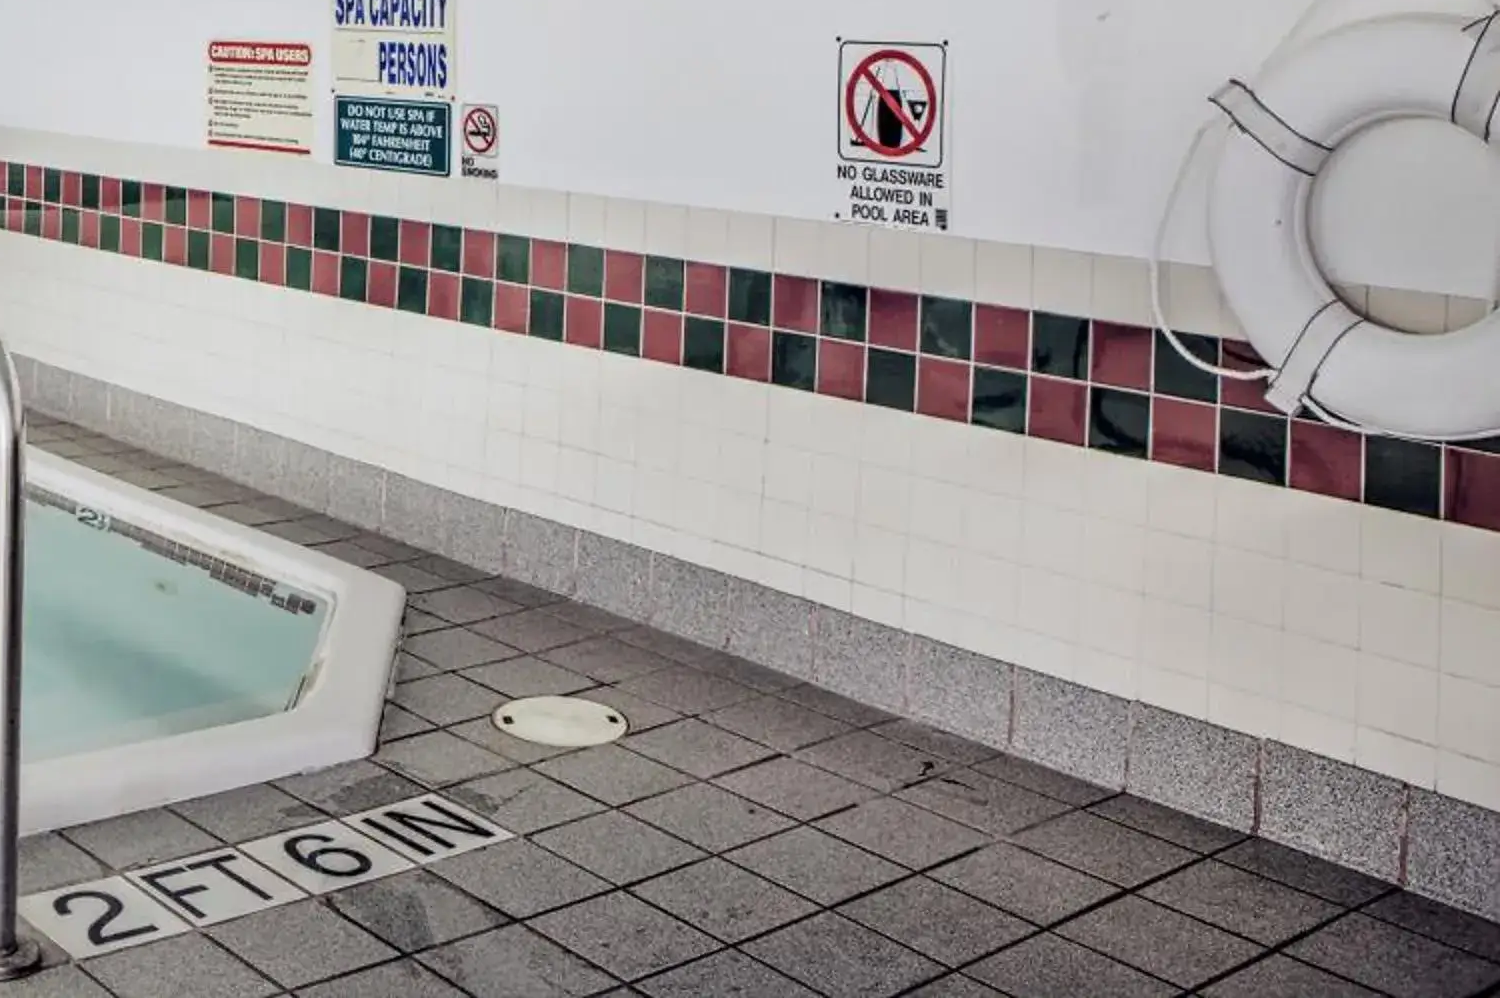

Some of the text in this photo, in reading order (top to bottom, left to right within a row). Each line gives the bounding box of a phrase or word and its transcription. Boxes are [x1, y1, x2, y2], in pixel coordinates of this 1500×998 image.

[255, 47, 275, 61] SPA
[276, 48, 309, 63] USERS
[379, 42, 447, 88] PERSONS
[347, 104, 436, 123] DO NOT USE SPA IF
[340, 118, 443, 139] WATER TEMP IS ABOVE
[371, 135, 431, 152] FAHRENHEIT
[461, 156, 498, 179] NO SMOKING
[837, 165, 944, 189] NO GLASSWARE
[850, 185, 933, 207] ALLOWED IN
[851, 204, 888, 221] POOL
[893, 209, 930, 227] AREA
[52, 800, 497, 947] 2 FT 6 IN
